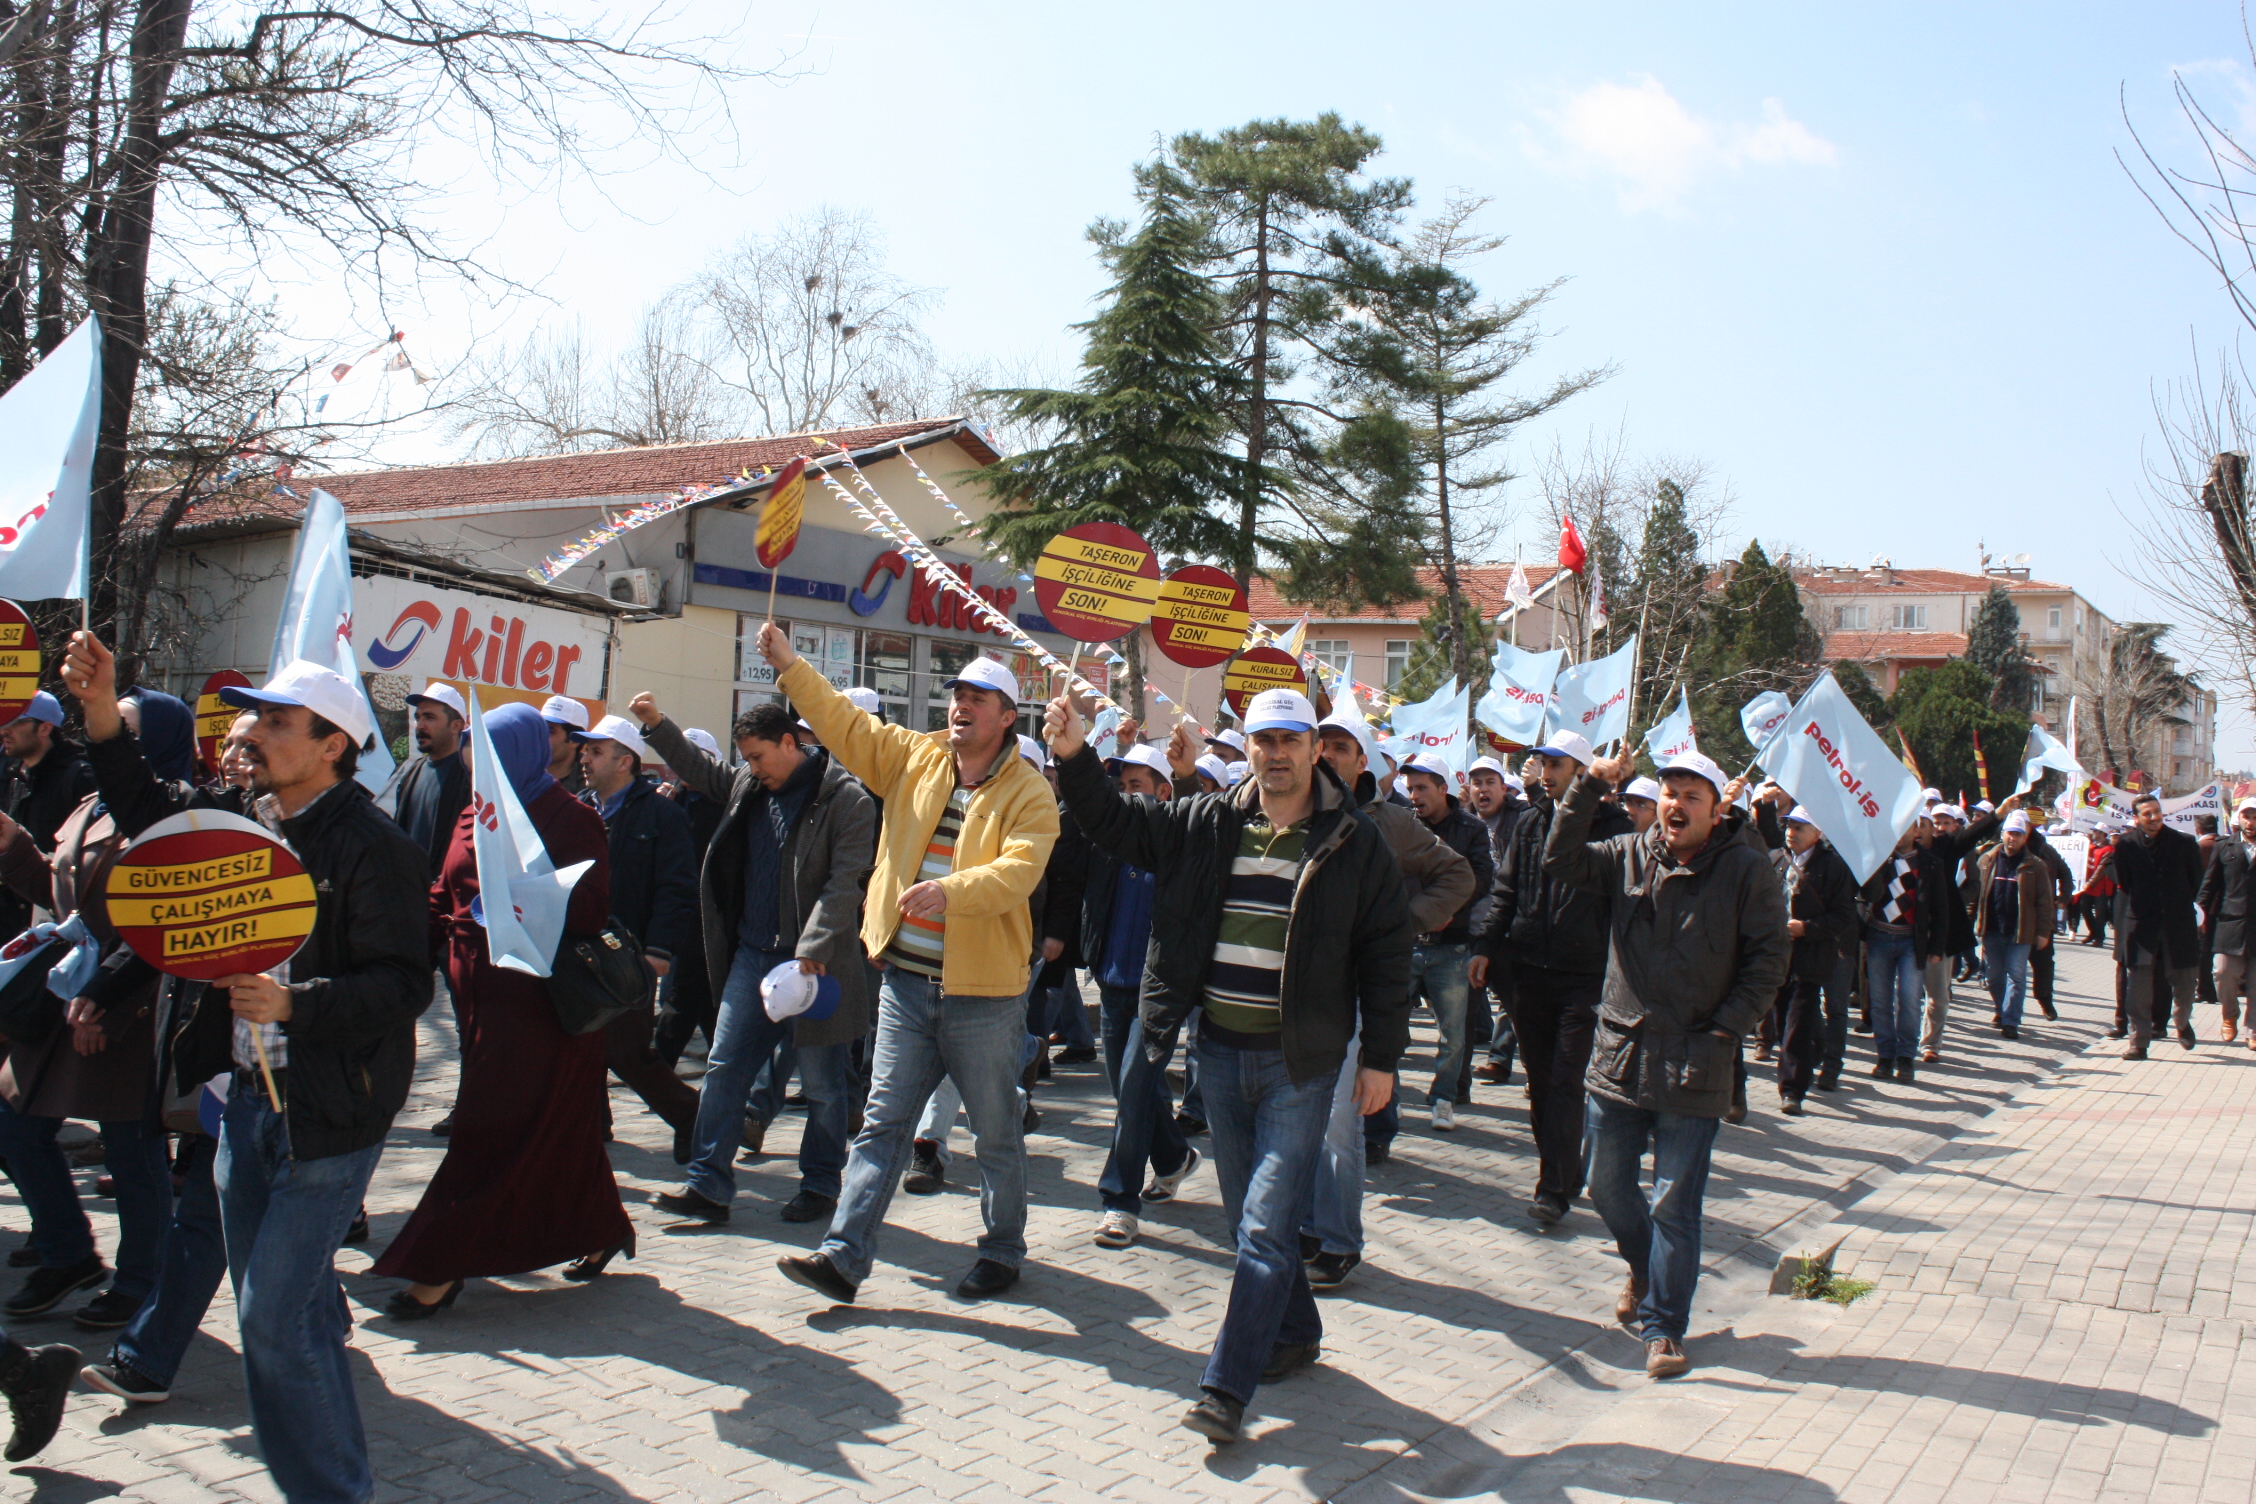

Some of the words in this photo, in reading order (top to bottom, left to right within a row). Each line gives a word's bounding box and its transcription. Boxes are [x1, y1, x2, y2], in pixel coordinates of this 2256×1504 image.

[1080, 545, 1140, 567] TAŞERON
[1061, 564, 1137, 591] İŞÇİLİĞİNE
[1065, 592, 1108, 612] SON!
[1182, 586, 1231, 602] TAŞERON
[1169, 603, 1229, 623] İŞÇİLİĞİNE
[0, 628, 21, 641] SIZ
[1174, 626, 1208, 642] SON!
[443, 607, 582, 695] kiler
[1250, 664, 1294, 676] KURALSIZ
[830, 676, 848, 688] 6,95
[1804, 721, 1880, 818] petrol-iş
[129, 854, 266, 888] GÜVENCESİZ
[151, 887, 273, 924] ÇALIŞMAYA
[170, 920, 257, 951] HAYIR!
